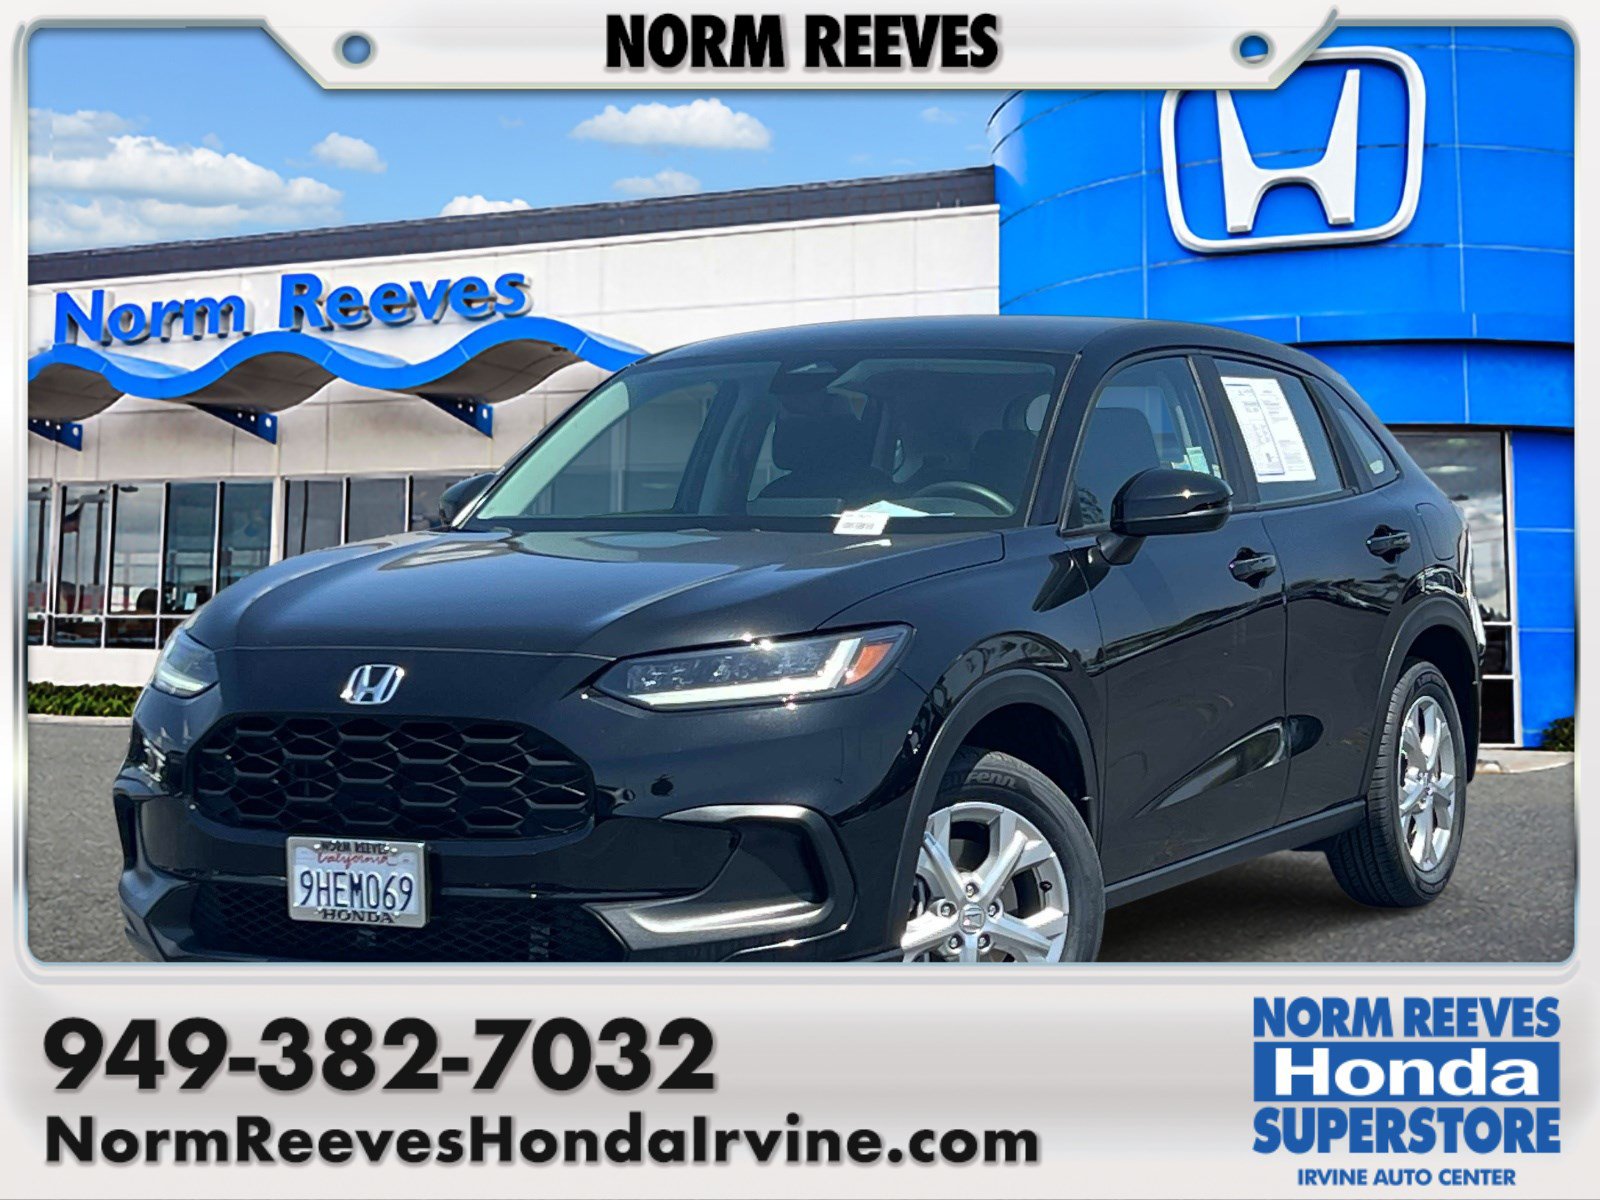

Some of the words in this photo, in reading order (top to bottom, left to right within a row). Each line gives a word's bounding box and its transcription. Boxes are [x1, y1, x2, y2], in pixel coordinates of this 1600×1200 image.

[54, 289, 247, 345] Norm
[279, 272, 529, 329] Reeves
[300, 870, 414, 912] 9HEM069
[321, 908, 396, 924] HONDA
